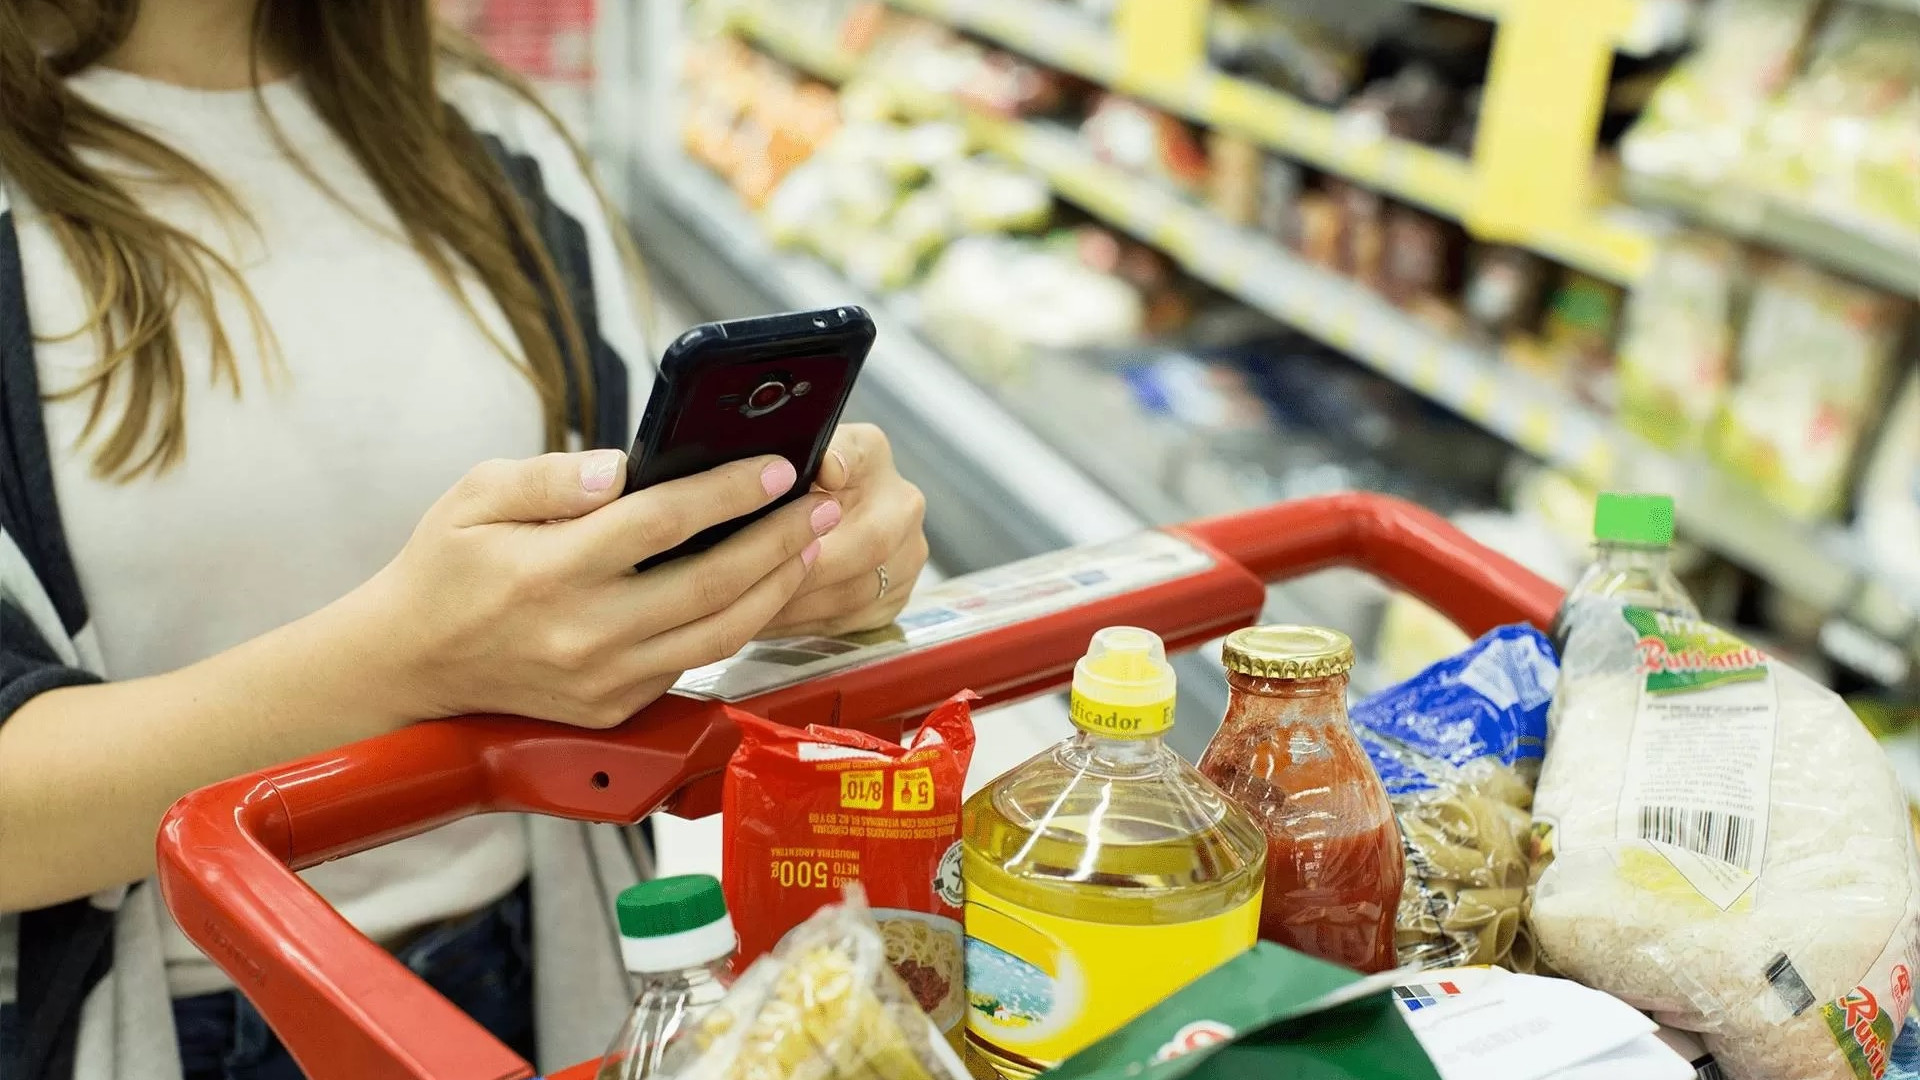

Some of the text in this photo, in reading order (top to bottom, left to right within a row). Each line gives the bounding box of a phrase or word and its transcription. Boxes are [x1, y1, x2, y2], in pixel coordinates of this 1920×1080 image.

[917, 780, 929, 805] 5
[816, 848, 860, 860] INDUSTRIA
[770, 860, 828, 888] 500g
[833, 861, 860, 875] NETO
